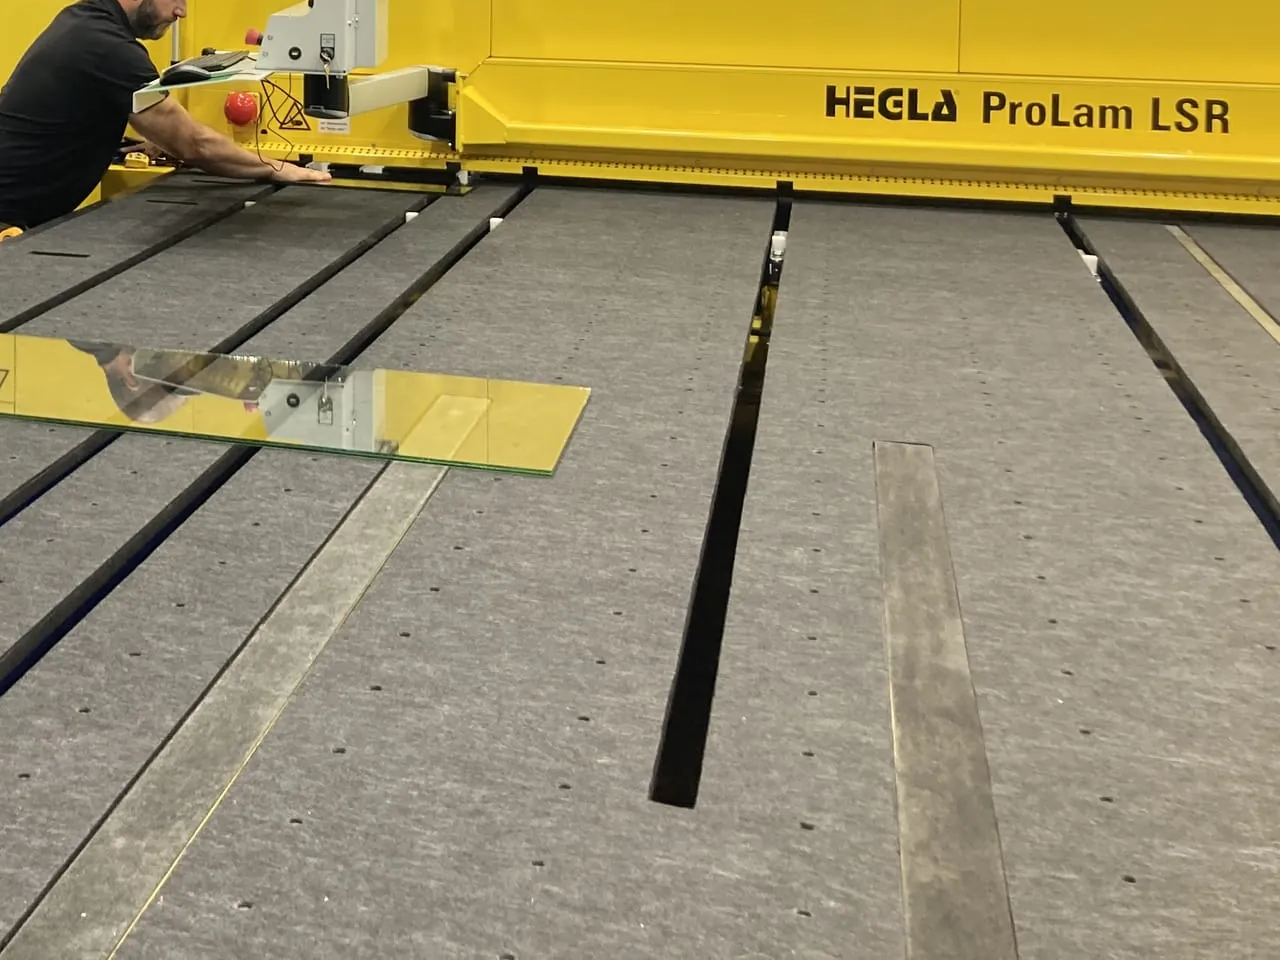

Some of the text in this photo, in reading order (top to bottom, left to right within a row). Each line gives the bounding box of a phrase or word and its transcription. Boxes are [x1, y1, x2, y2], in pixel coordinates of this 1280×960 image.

[825, 85, 1230, 133] HEGLA ProLam LSR
